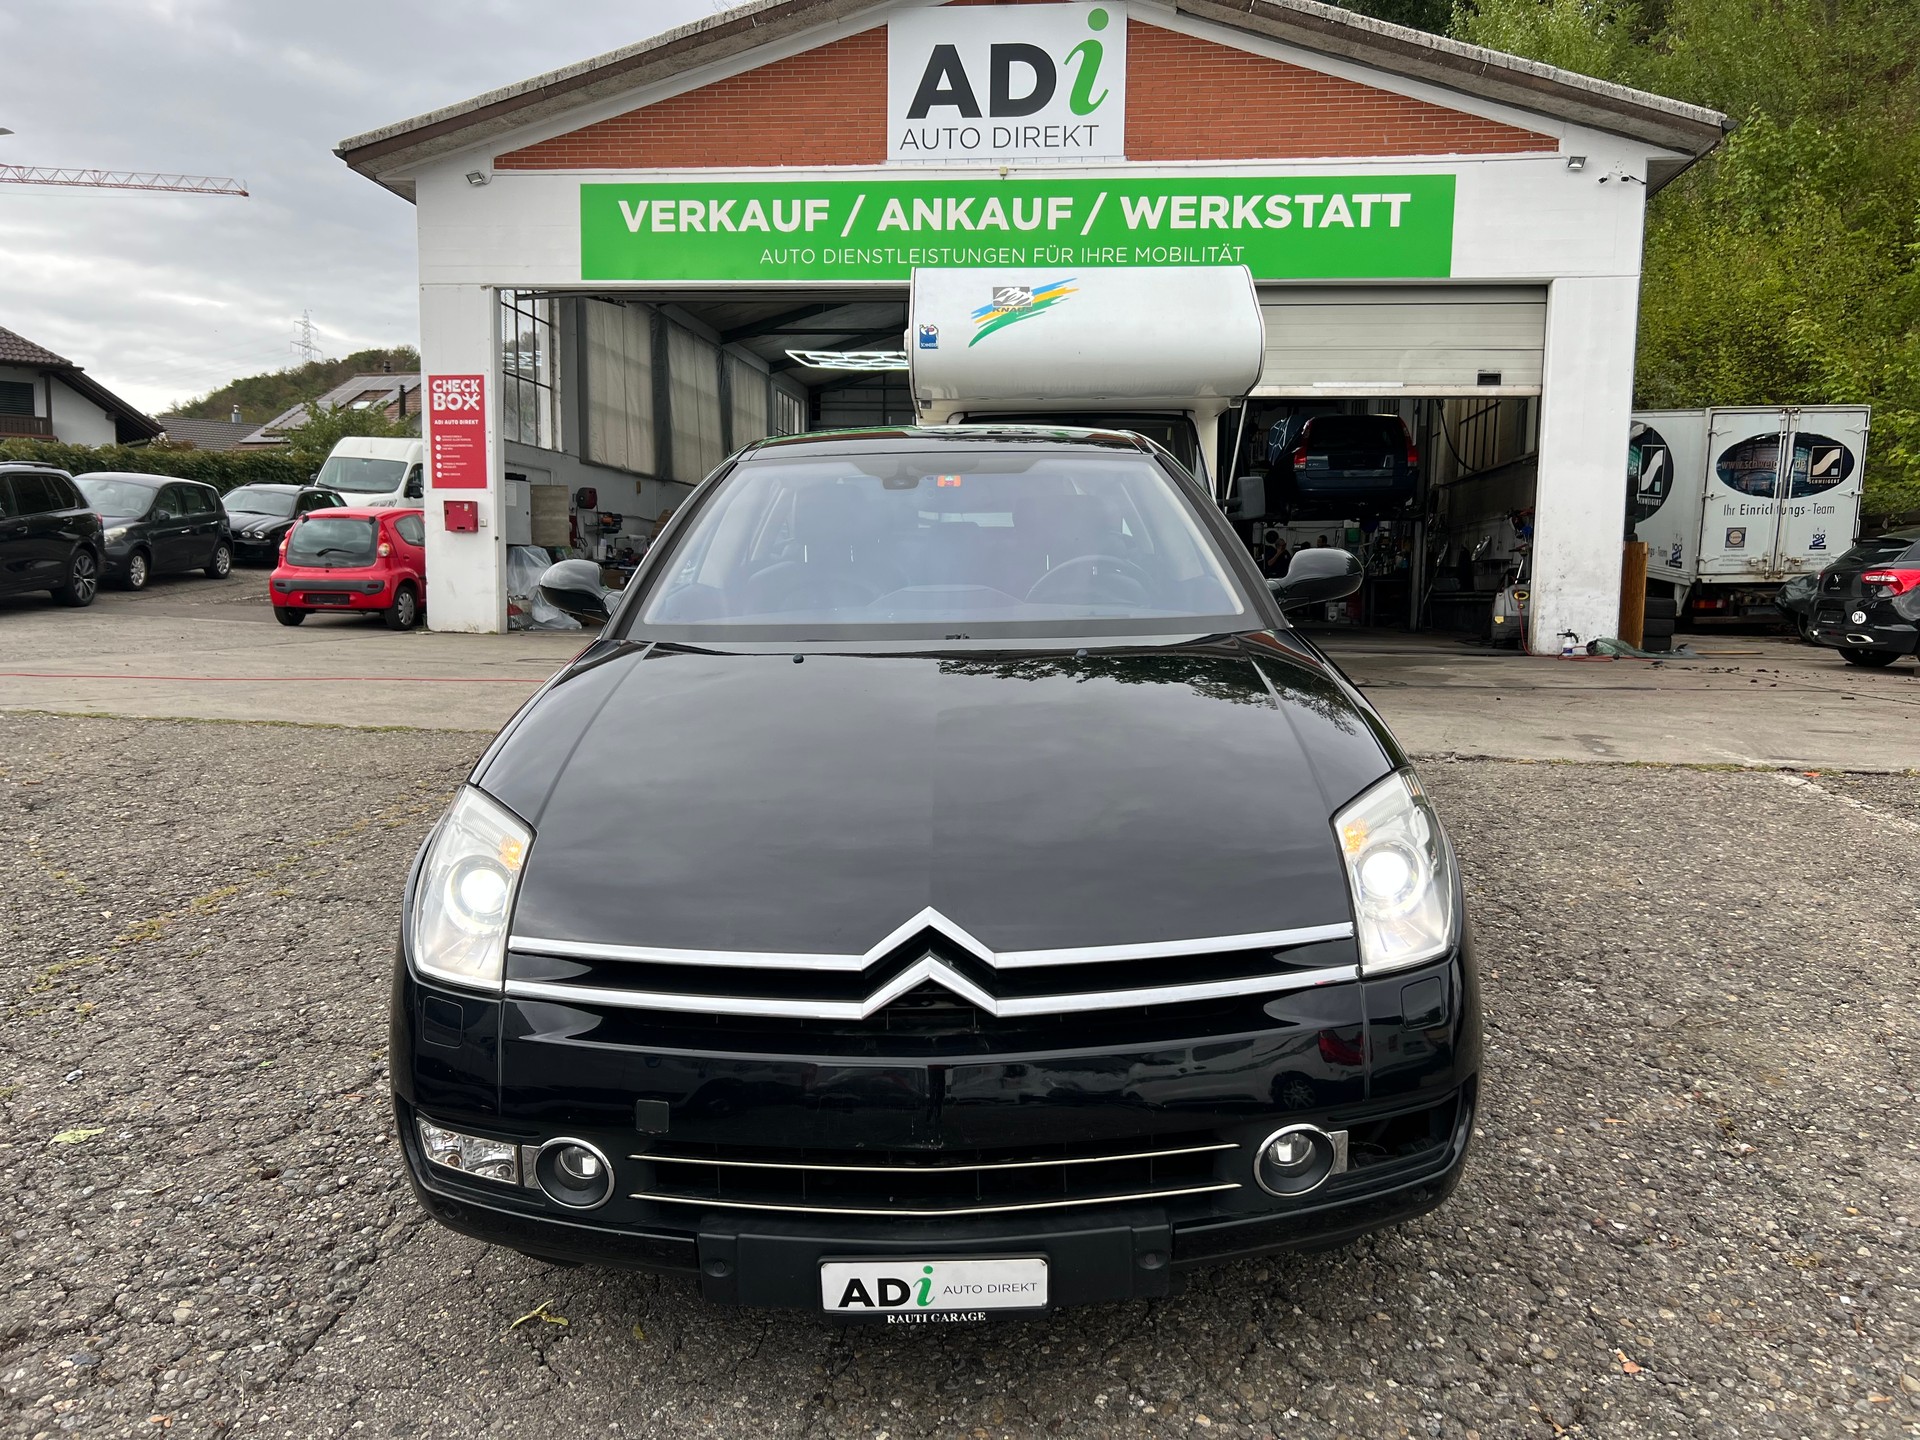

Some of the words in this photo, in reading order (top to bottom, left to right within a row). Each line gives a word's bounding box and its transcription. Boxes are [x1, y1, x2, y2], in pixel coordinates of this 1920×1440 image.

[899, 127, 981, 150] AUTO
[993, 125, 1100, 149] DIREKT
[618, 199, 829, 232] VERKAUF
[840, 194, 866, 237] /
[876, 197, 1073, 231] ANKAUF
[1080, 192, 1108, 235] /
[1119, 193, 1411, 230] WERKSTATT
[760, 249, 815, 264] AUTO
[823, 248, 1026, 264] DIENSTLEISTUNGEN
[1033, 244, 1074, 263] FÜR
[1081, 247, 1128, 263] IHRE
[1135, 244, 1245, 263] MOBILITÄT
[432, 379, 480, 393] CHECK
[433, 392, 480, 411] BOX
[1723, 503, 1736, 516] Ihr
[1853, 612, 1863, 622] CH
[943, 1284, 982, 1294] AUTO
[987, 1282, 1038, 1294] DIREKT
[887, 1314, 927, 1324] RAUTI
[930, 1312, 986, 1323] GARAGE
